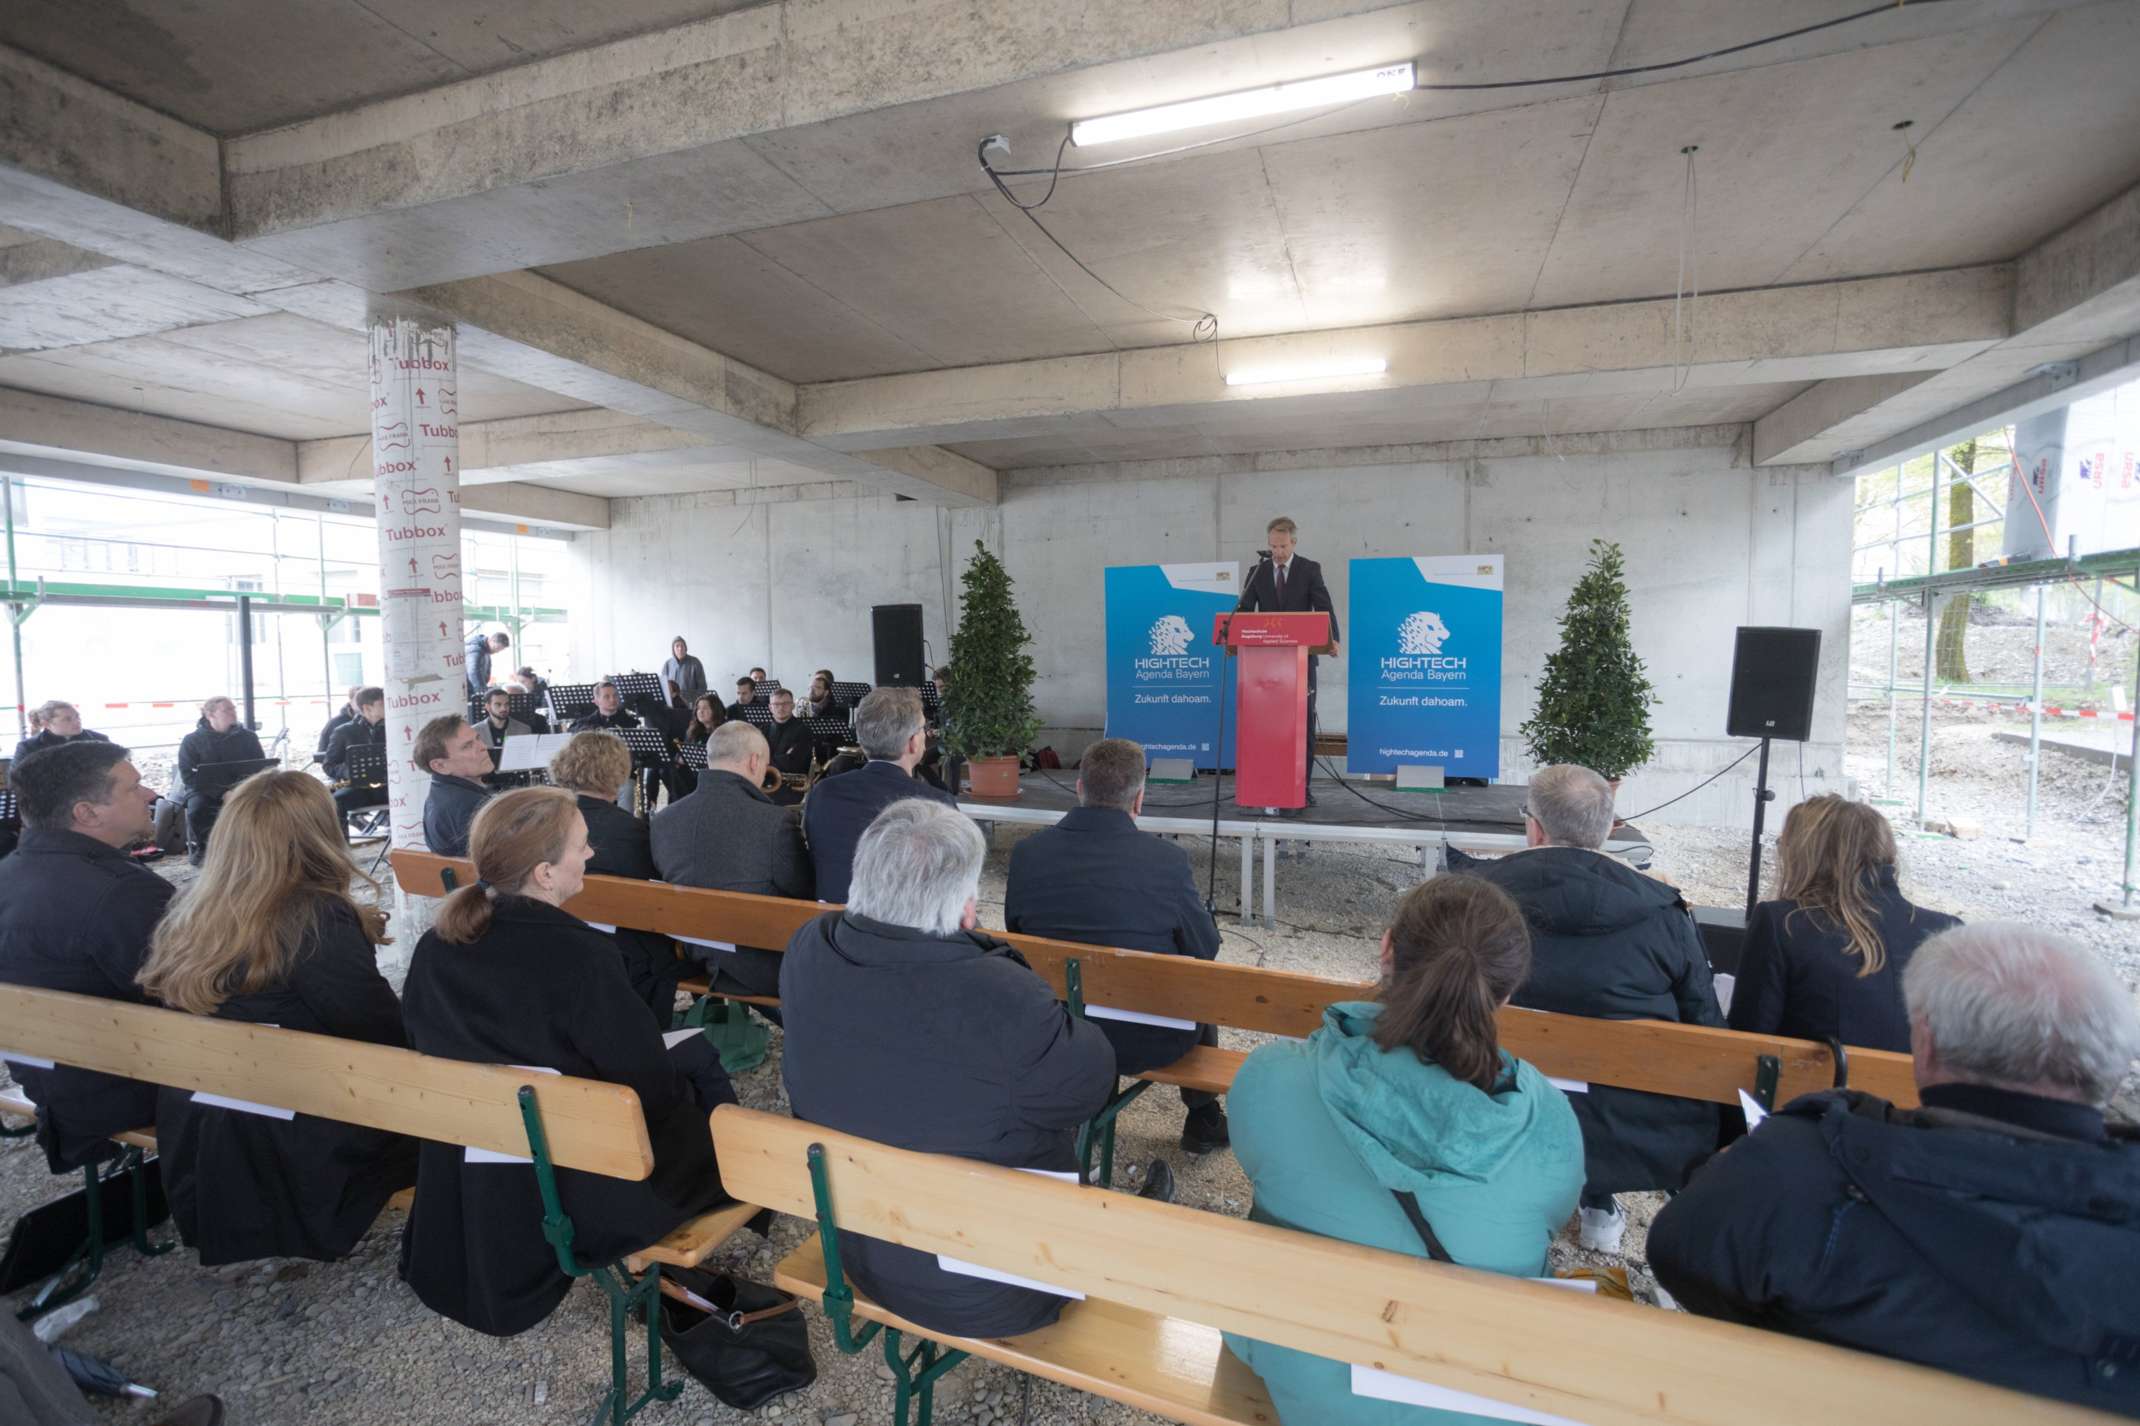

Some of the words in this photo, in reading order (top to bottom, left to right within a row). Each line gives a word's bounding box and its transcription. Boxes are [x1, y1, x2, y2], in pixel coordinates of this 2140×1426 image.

[419, 424, 458, 439] Tubb
[385, 525, 446, 541] Tubbox
[1135, 657, 1210, 669] HIGHTECH
[1381, 657, 1466, 669] HIGHTECH
[1135, 669, 1173, 680] Agenda
[1175, 669, 1210, 680] Bayern
[1381, 669, 1424, 681] Agenda
[1427, 669, 1466, 682] Bayern
[387, 691, 441, 710] Tubbox
[1135, 694, 1170, 704] Zukunft
[1171, 694, 1212, 703] dahoam.
[1379, 695, 1419, 706] Zukunft
[1421, 696, 1468, 707] dahoam.
